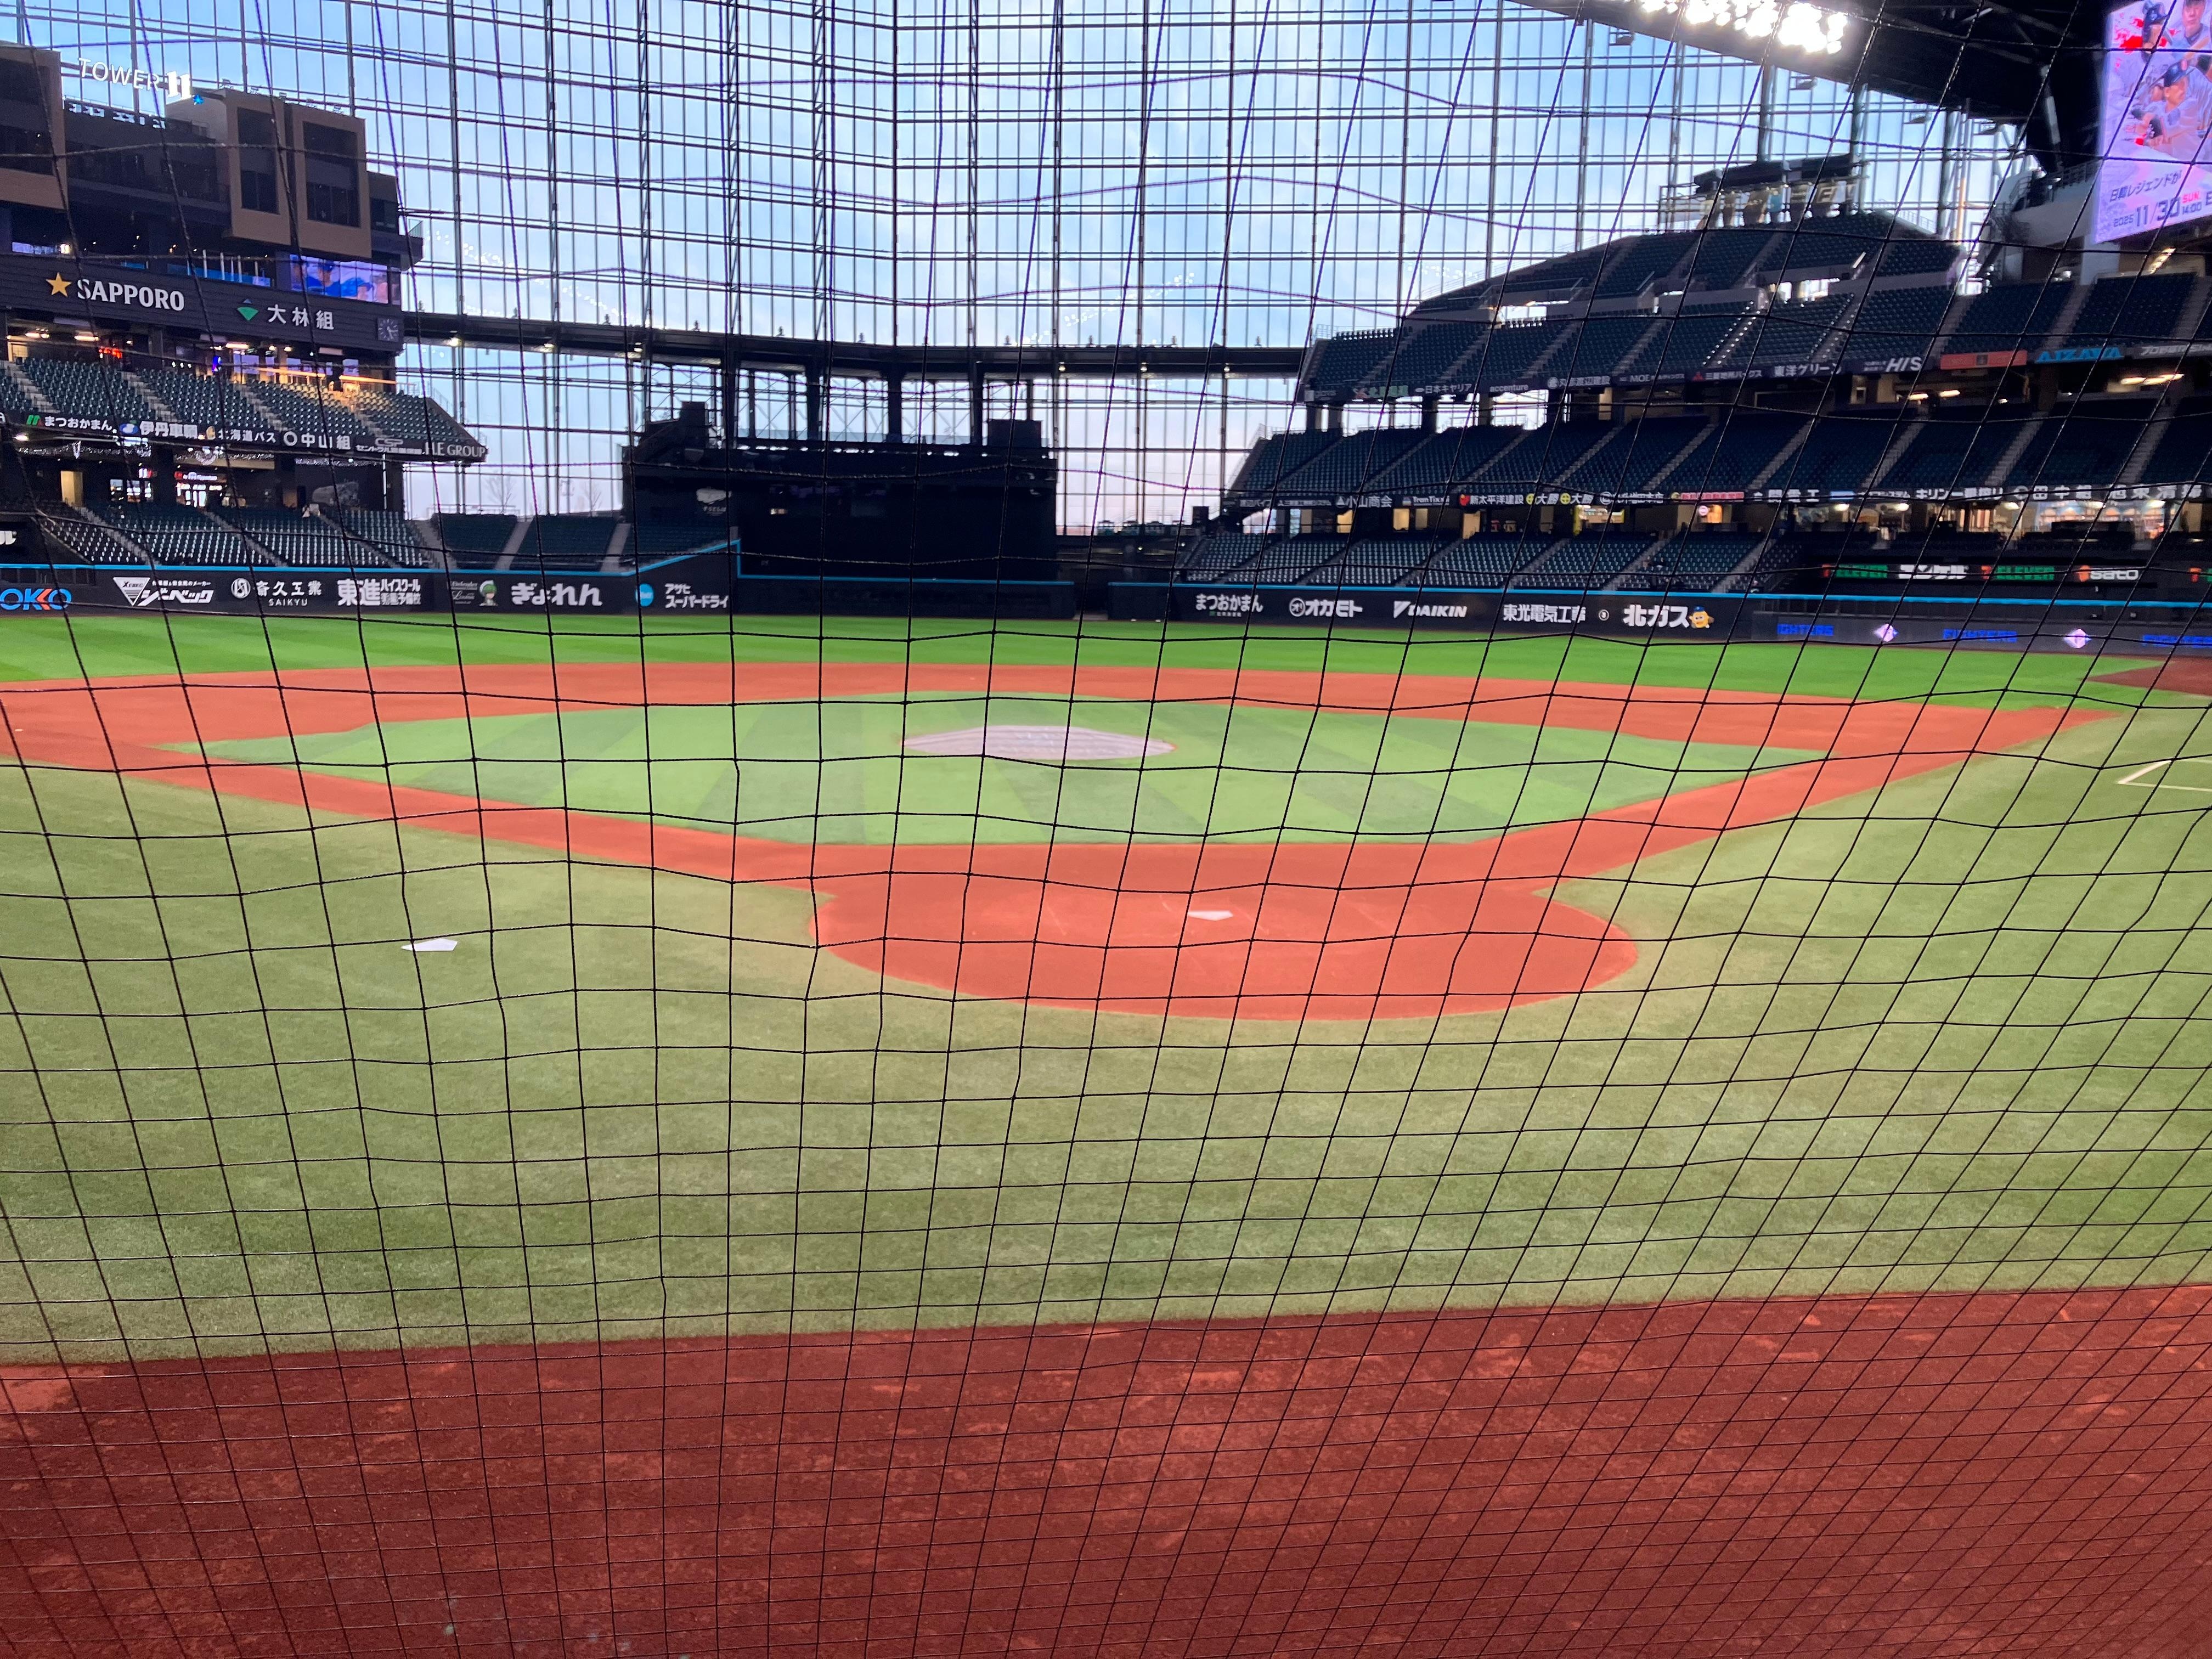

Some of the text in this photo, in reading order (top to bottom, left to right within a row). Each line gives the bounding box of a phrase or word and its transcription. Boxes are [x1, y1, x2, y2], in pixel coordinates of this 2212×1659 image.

[78, 58, 191, 100] TOWER 11
[77, 279, 185, 311] SAPPORO
[267, 304, 334, 330] 大林組
[1425, 383, 1472, 394] 日本キャリア
[1489, 384, 1529, 392] accenture
[301, 434, 351, 450] 中山組
[447, 444, 486, 458] GROUP
[1345, 495, 1392, 508] 小山商会
[1470, 495, 1524, 505] 新太平洋建設
[337, 578, 381, 606] 東進
[381, 578, 421, 592] ハイスクール
[665, 583, 691, 594] アサヒ
[138, 588, 214, 606] ジーベック
[511, 582, 603, 606] ぎょれん
[665, 595, 729, 608] スーパードライ
[268, 598, 308, 606] SAIKYU
[1195, 594, 1263, 613] まつおかまん
[1305, 599, 1363, 617] オカモト
[1408, 605, 1467, 618] DAIKIN
[1622, 604, 1689, 628] 北ガス
